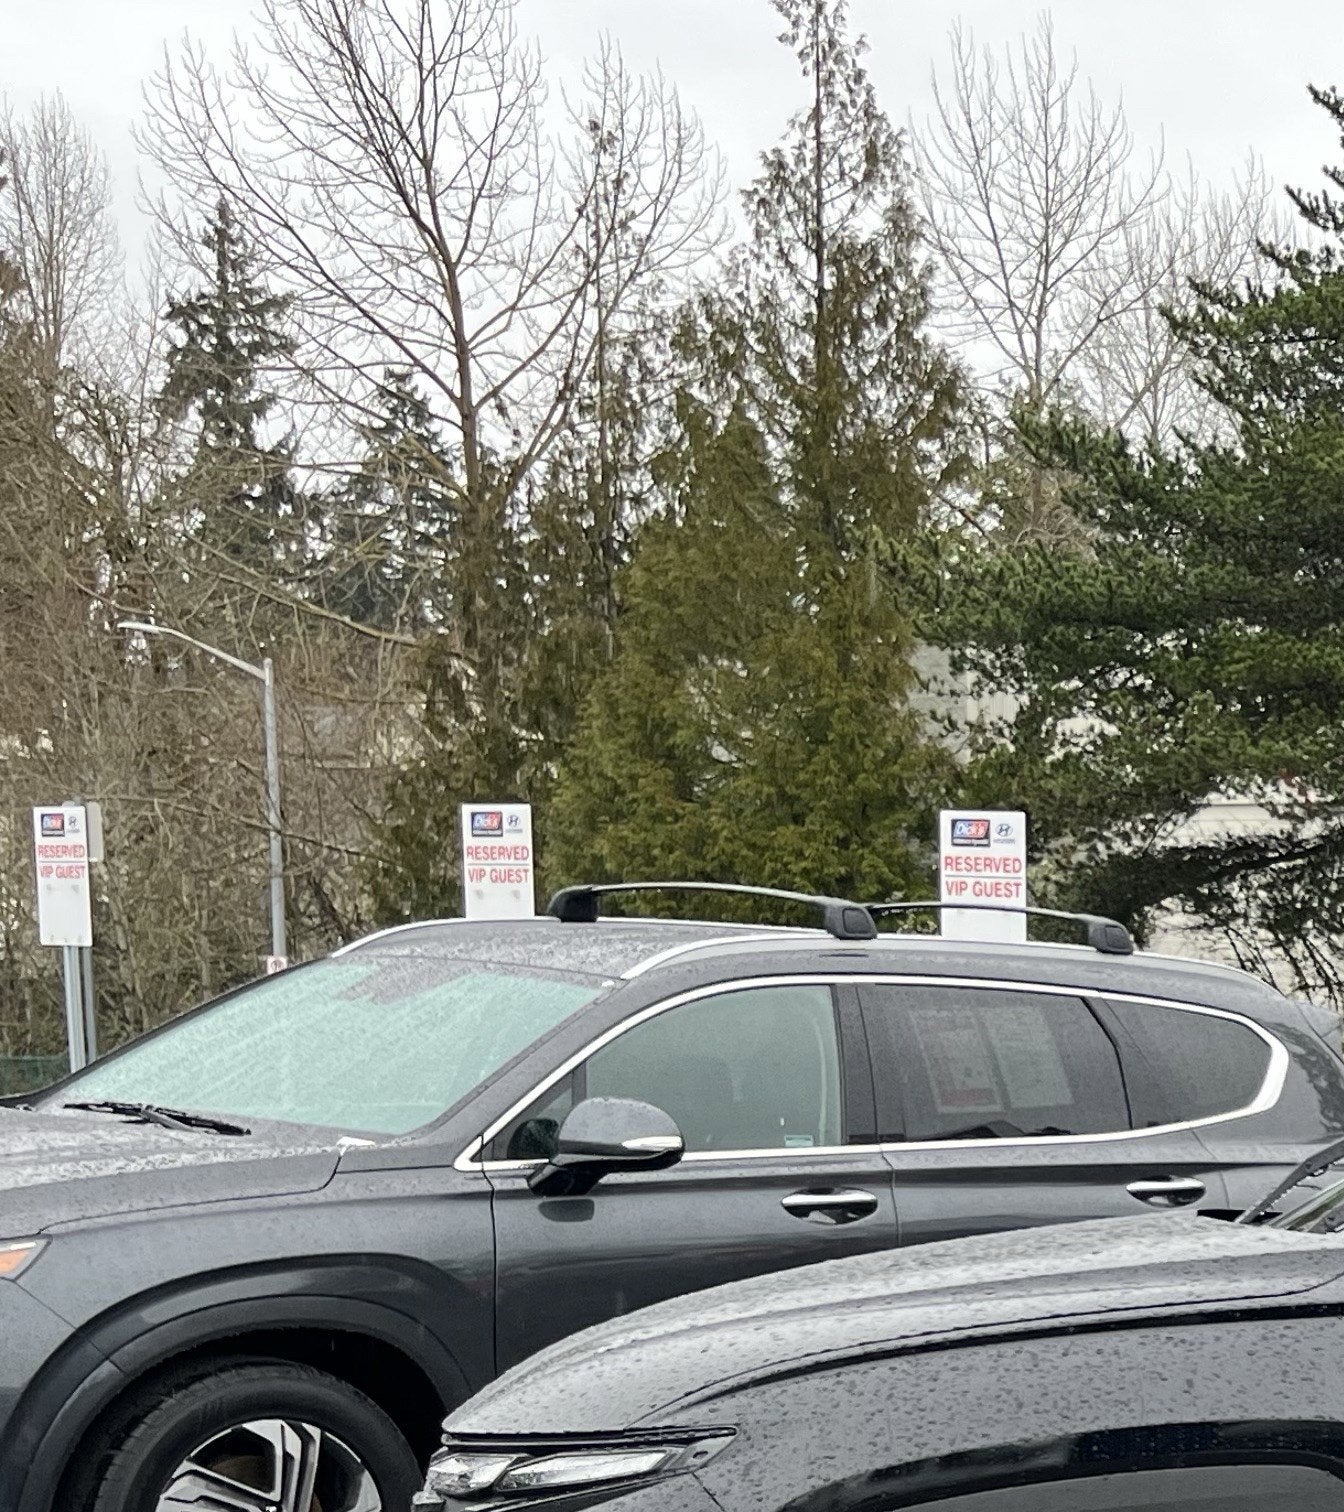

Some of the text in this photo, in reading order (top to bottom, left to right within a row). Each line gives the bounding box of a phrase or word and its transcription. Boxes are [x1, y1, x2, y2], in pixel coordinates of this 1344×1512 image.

[38, 844, 85, 858] RESERVED
[466, 845, 530, 861] RESERVED
[40, 865, 85, 879] VIP GUEST
[944, 856, 1022, 873] RESERVED
[468, 868, 530, 884] VIP GUEST
[945, 881, 1022, 898] VIP GUEST
